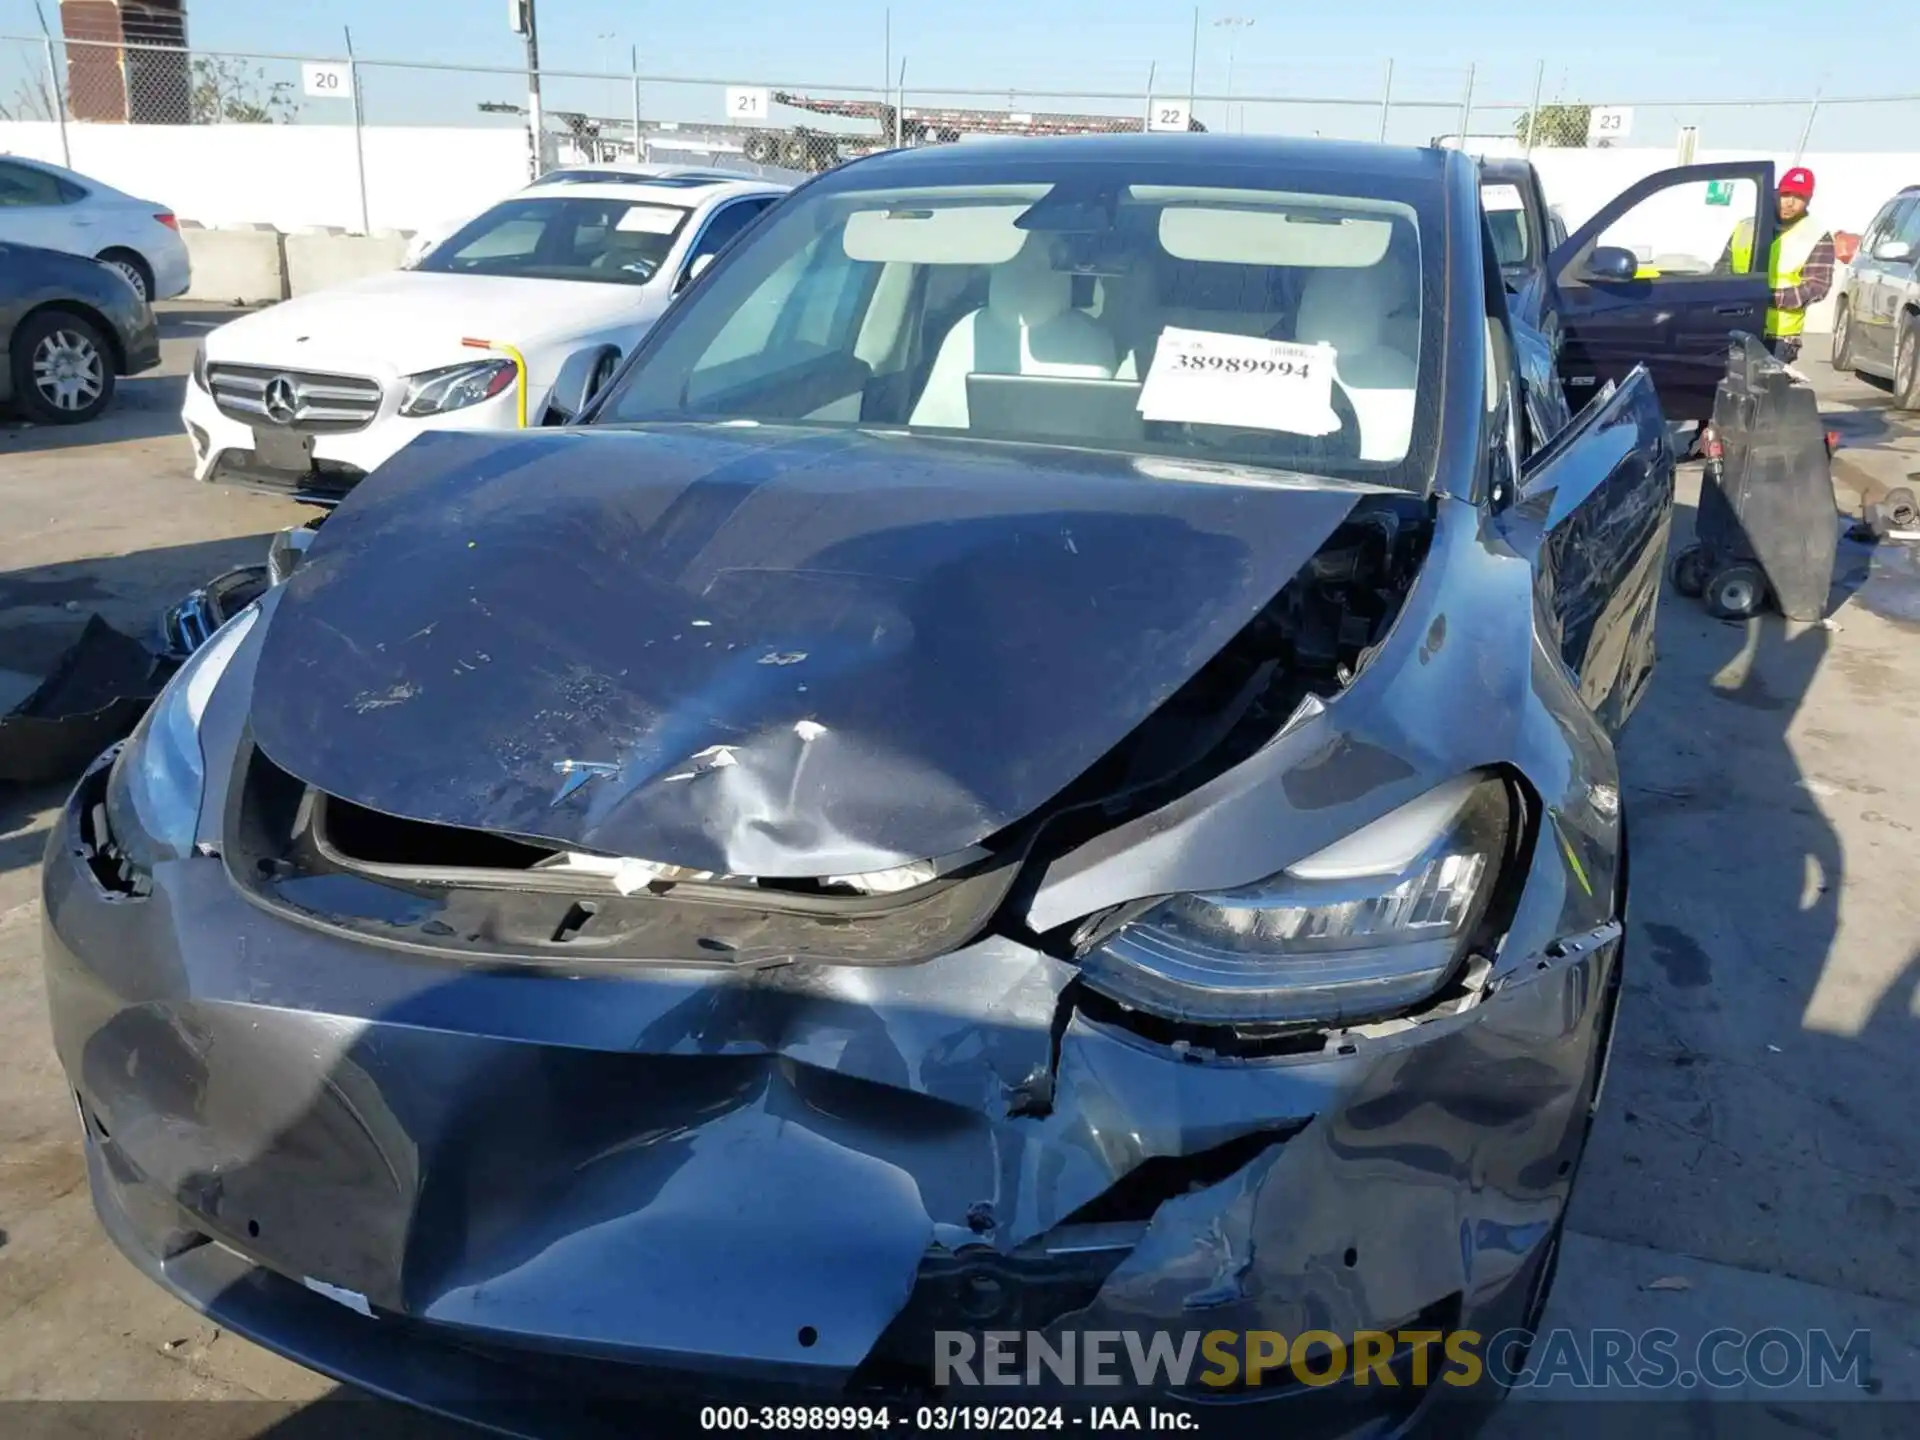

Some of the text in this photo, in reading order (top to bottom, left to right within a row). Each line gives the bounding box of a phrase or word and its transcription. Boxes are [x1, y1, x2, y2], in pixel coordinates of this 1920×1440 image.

[315, 72, 338, 89] 20
[738, 95, 757, 111] 21
[1160, 109, 1181, 124] 22
[1600, 115, 1622, 129] 23
[1171, 354, 1310, 380] 38989994
